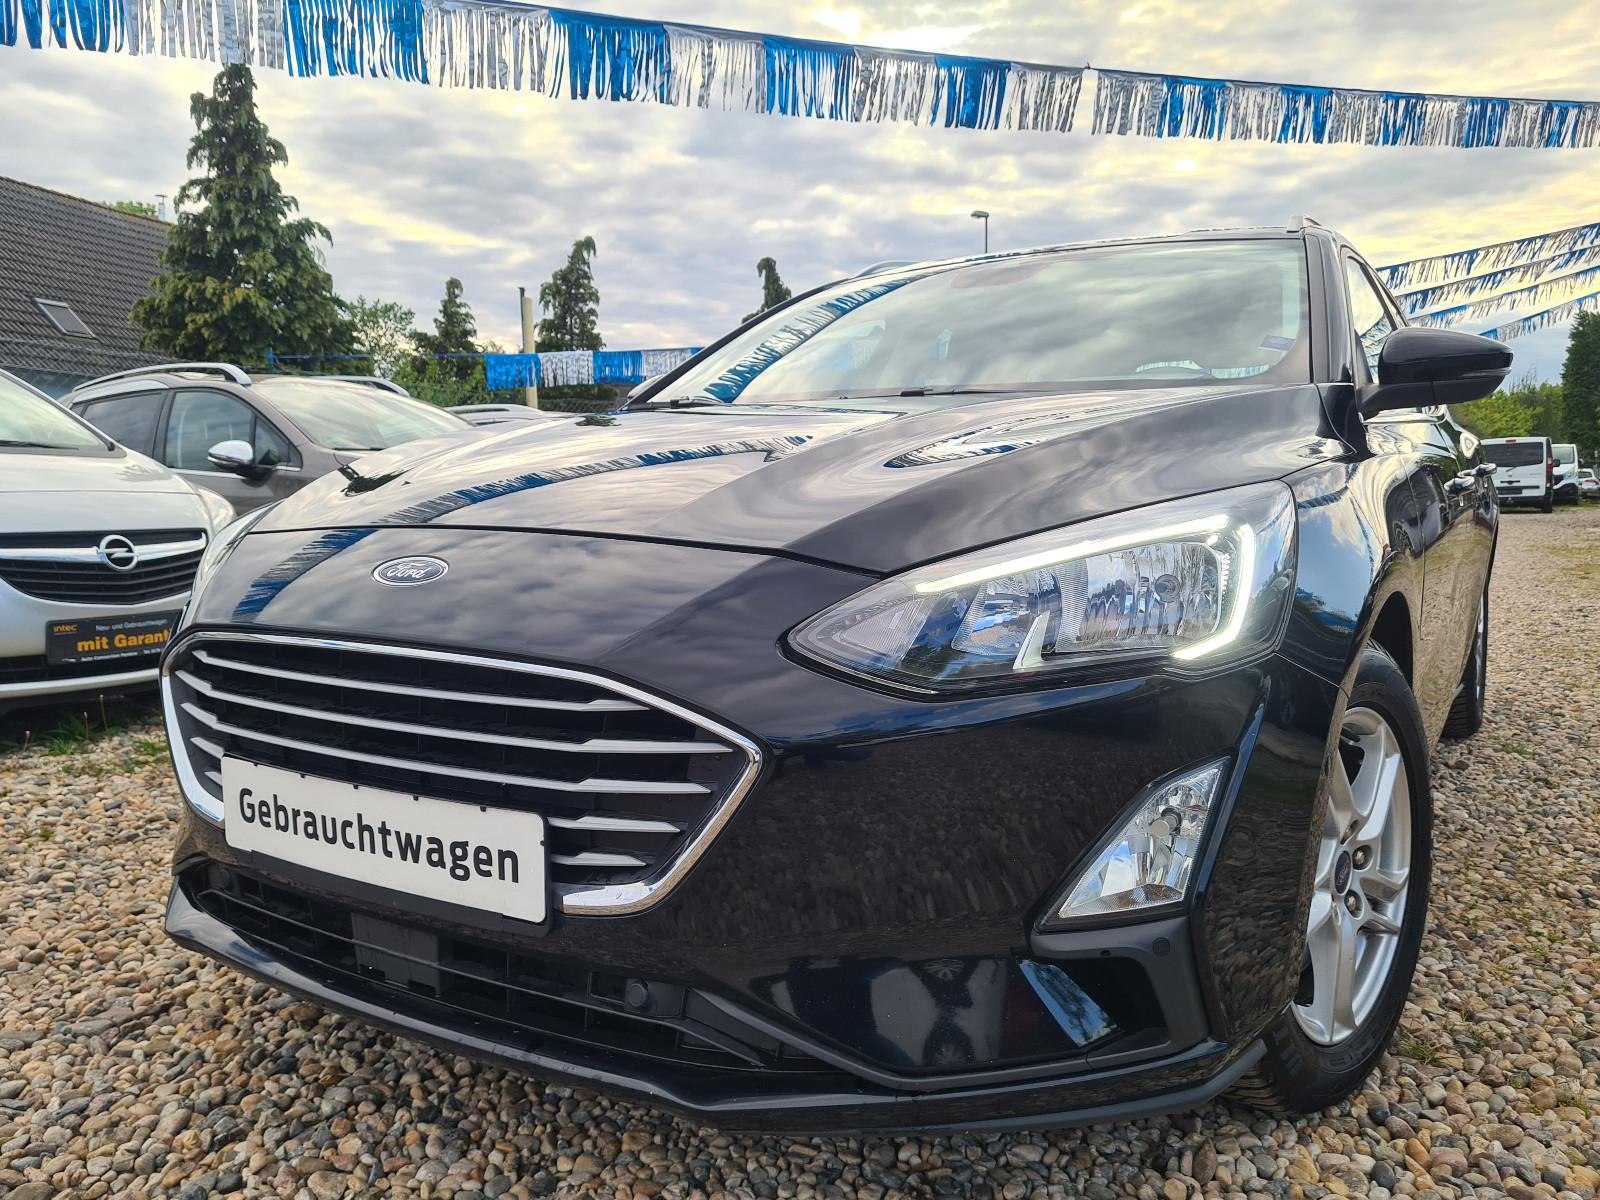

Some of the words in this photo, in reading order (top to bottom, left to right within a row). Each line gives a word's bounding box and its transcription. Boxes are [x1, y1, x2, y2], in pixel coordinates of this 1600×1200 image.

[386, 562, 432, 579] Ford
[53, 624, 78, 633] intec
[77, 635, 109, 652] mit
[114, 629, 170, 647] Garant
[239, 787, 519, 884] Gebrauchtwagen
